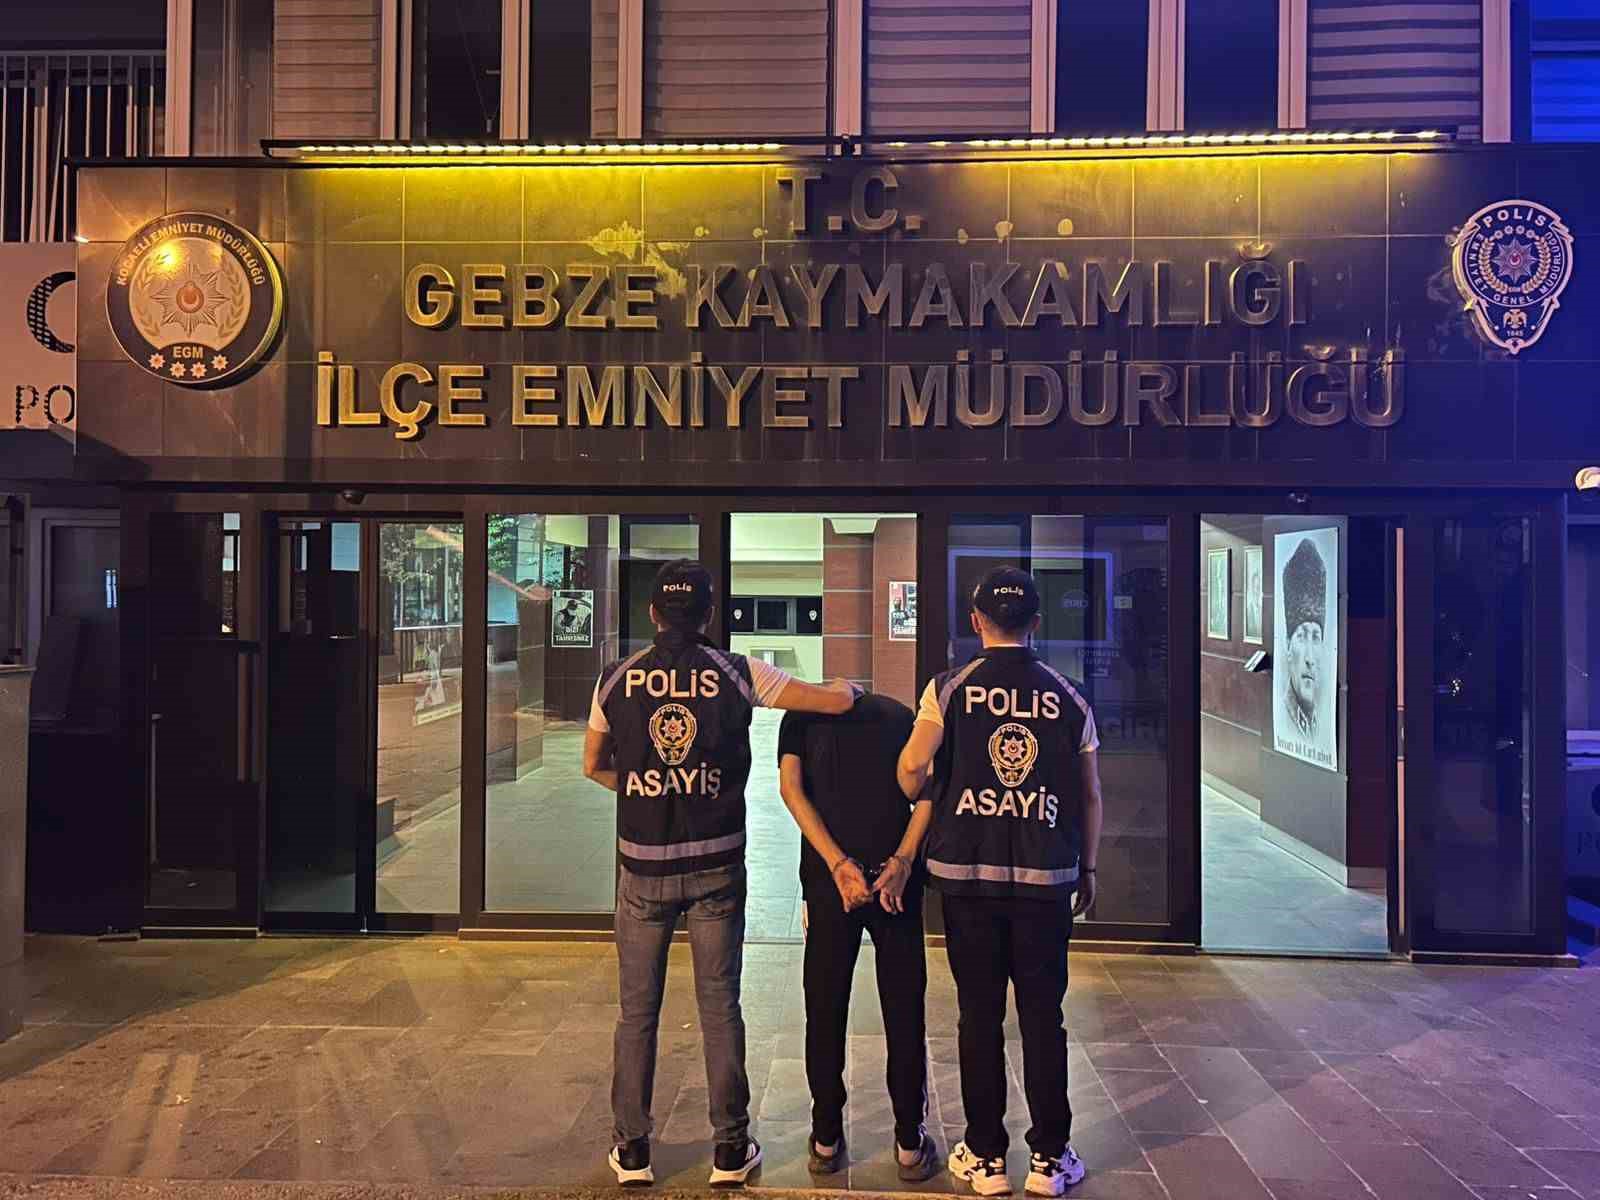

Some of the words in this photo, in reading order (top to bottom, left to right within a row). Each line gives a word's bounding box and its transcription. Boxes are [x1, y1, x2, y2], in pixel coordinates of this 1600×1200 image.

[777, 168, 922, 232] T.C.
[1482, 207, 1547, 228] POLİS
[150, 221, 204, 242] EMNİYET
[206, 224, 266, 286] MÜDÜRLÜĞÜ
[404, 263, 659, 330] GEBZE
[685, 240, 1307, 329] KAYMAKAMLIĞI
[1493, 293, 1534, 305] GENEL
[173, 346, 204, 359] EGM
[317, 351, 486, 440] İLÇE
[511, 351, 859, 428] EMNİYET
[888, 345, 1404, 428] MÜDÜRLÜĞÜ
[626, 762, 721, 799] ASAYİŞ
[955, 786, 1059, 828] ASAYİŞ
